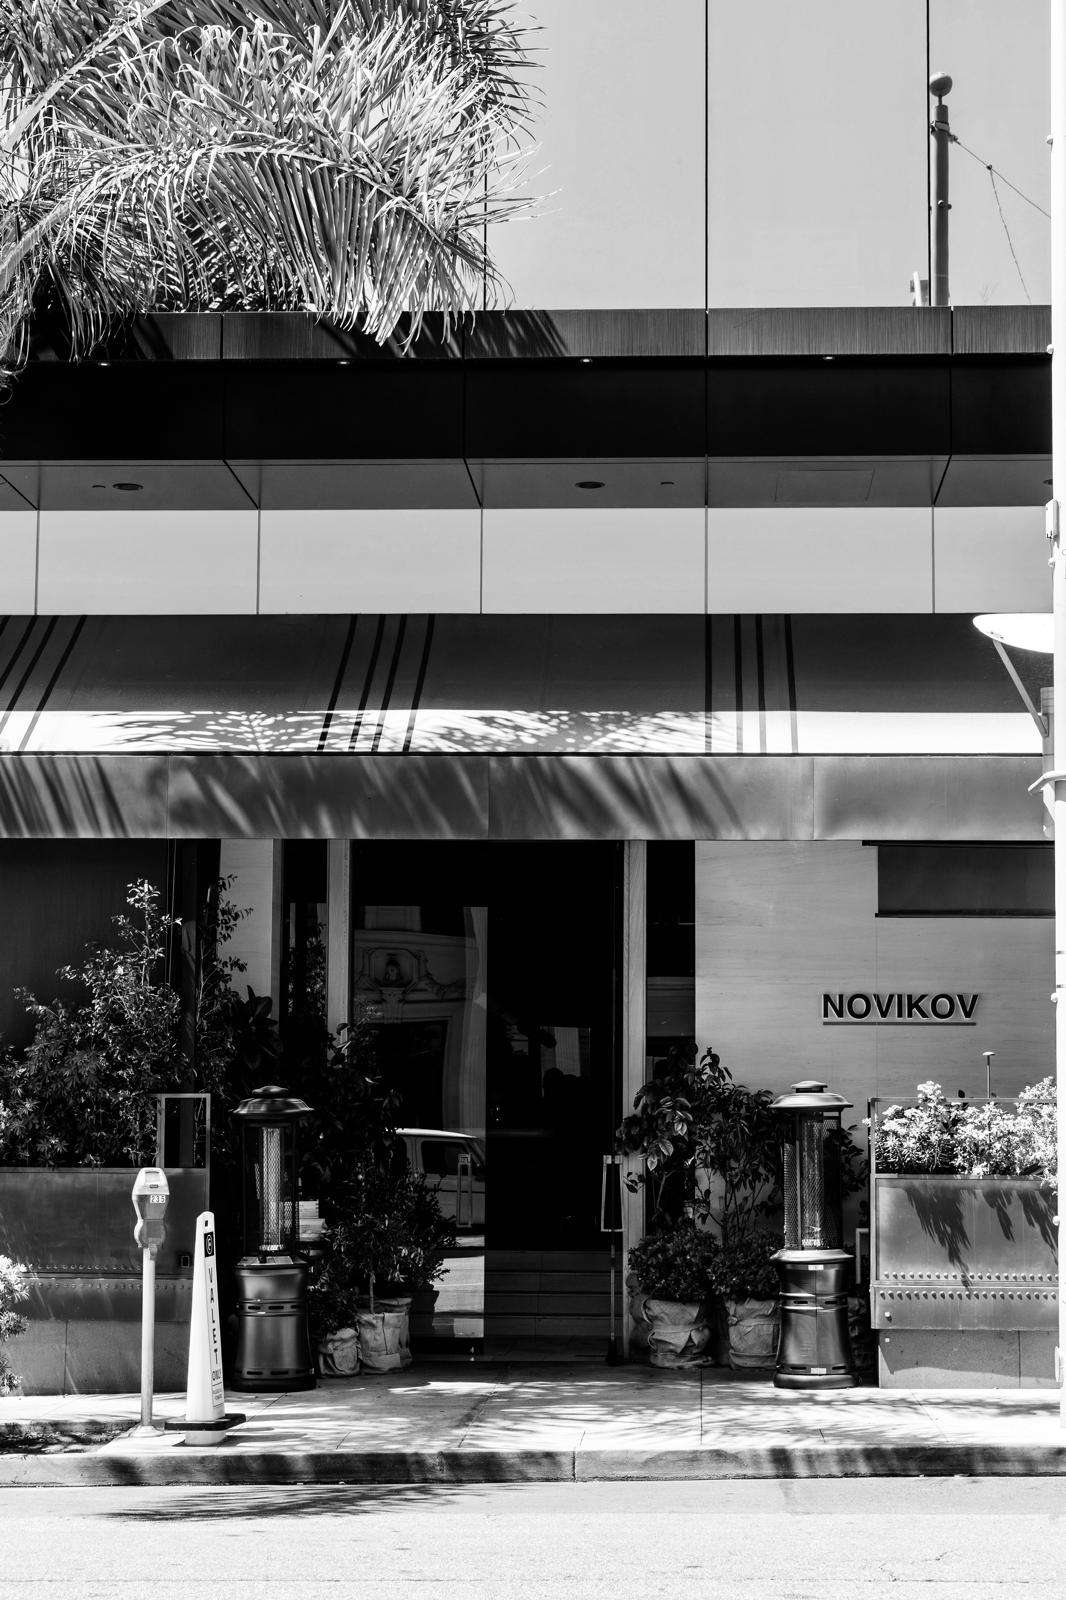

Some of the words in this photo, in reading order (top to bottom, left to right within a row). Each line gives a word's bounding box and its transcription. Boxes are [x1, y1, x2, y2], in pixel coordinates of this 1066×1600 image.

[823, 993, 979, 1019] NOVIKOV
[151, 1195, 165, 1203] 235
[208, 1267, 219, 1365] VALET
[212, 1368, 222, 1381] ONLY
